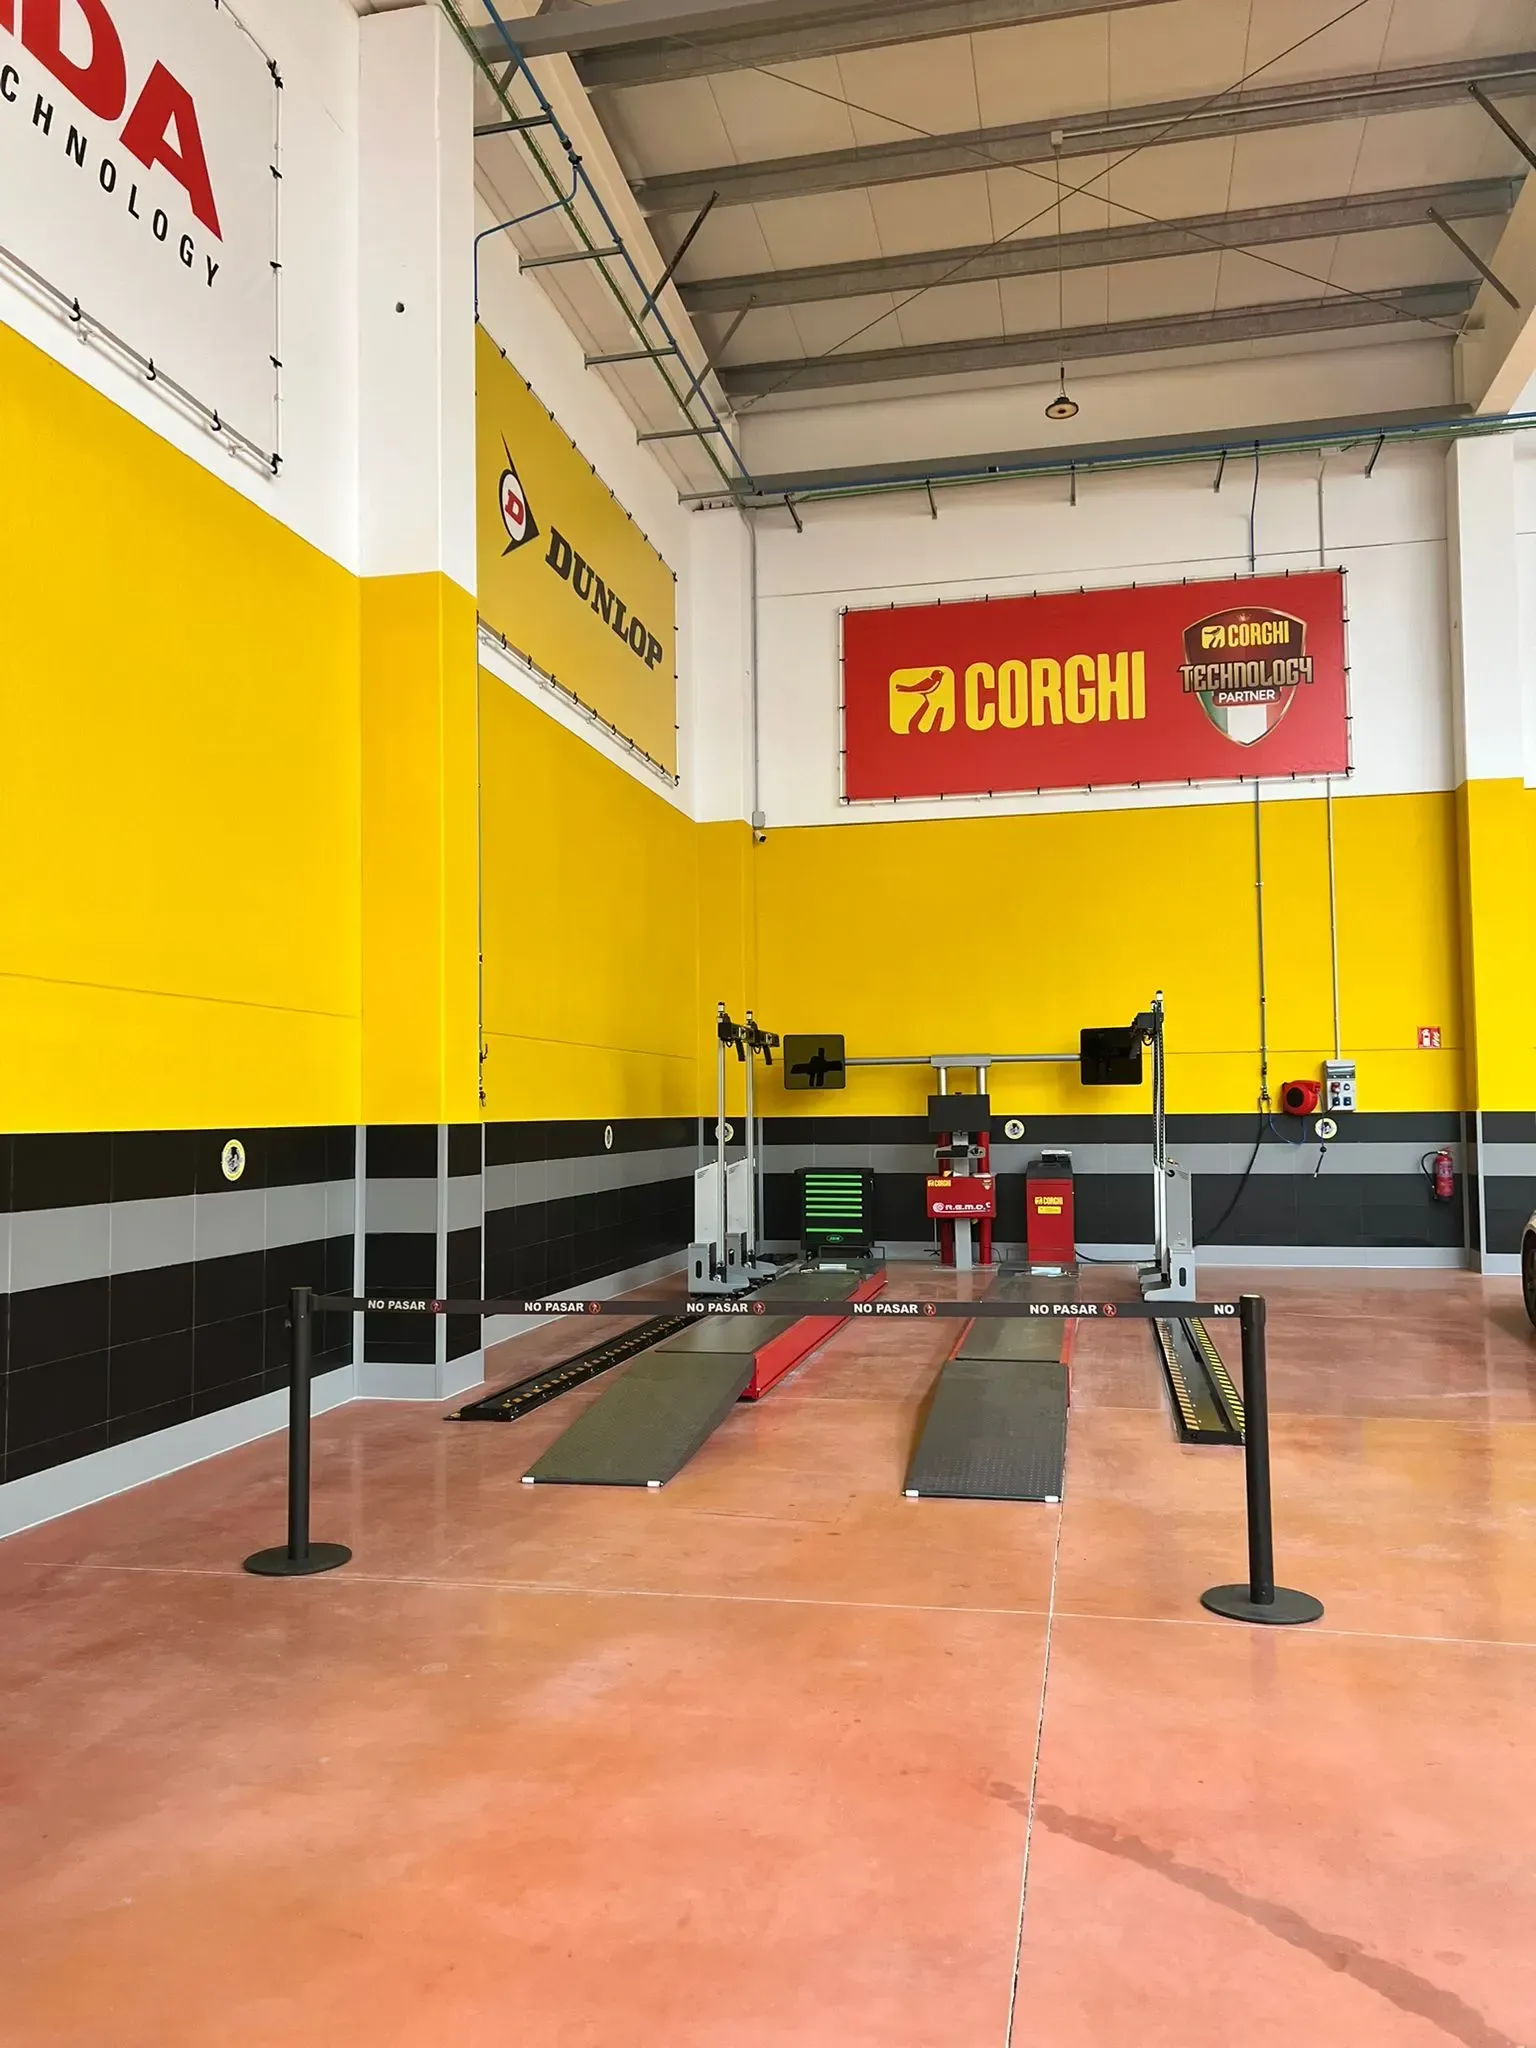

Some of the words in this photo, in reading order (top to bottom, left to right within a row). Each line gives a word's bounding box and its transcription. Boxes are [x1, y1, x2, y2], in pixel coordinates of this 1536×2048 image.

[545, 526, 663, 671] DUNLOP
[1227, 620, 1290, 648] CORGHI
[1178, 656, 1313, 692] TECHNOLOGY
[965, 650, 1145, 731] CORGHI
[1218, 689, 1275, 703] PARTNER
[367, 1299, 384, 1310] NO
[388, 1300, 426, 1311] PASAR
[524, 1302, 541, 1312] NO
[545, 1302, 584, 1312] PASAR
[686, 1302, 704, 1313] NO
[708, 1302, 748, 1313] PASAR
[853, 1303, 873, 1314] NO
[876, 1303, 918, 1314] PASAR
[1029, 1304, 1049, 1315] NO
[1053, 1304, 1097, 1315] PASAR
[1214, 1304, 1235, 1315] NO
